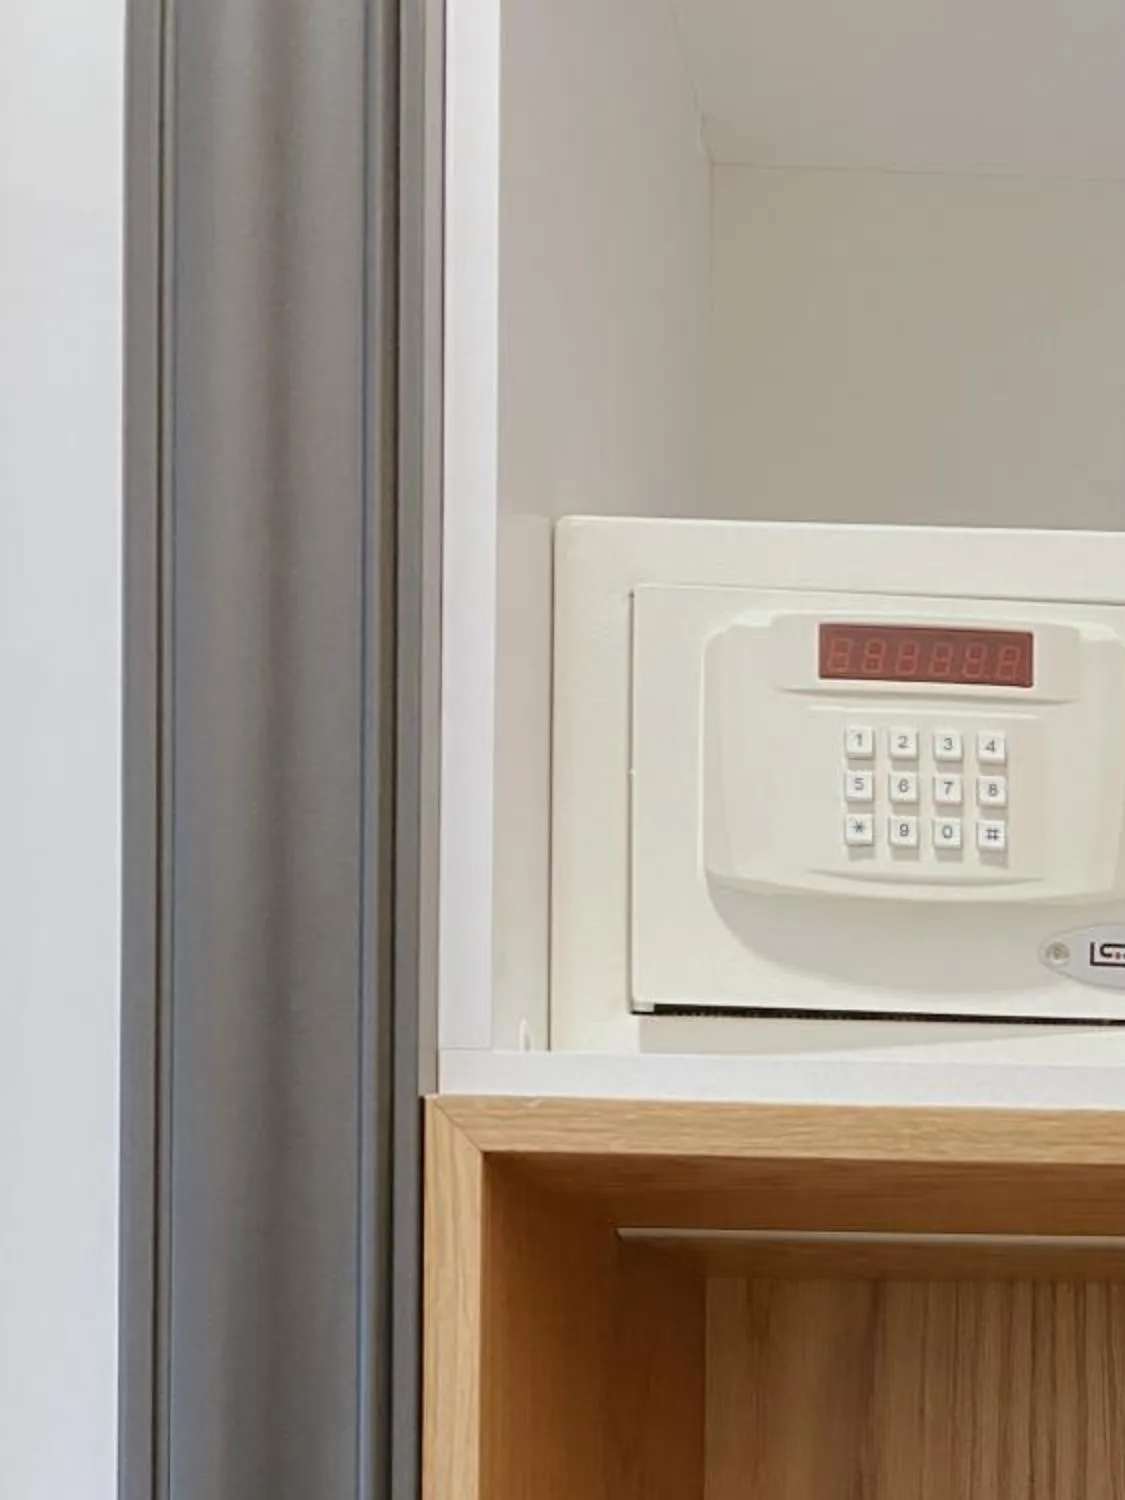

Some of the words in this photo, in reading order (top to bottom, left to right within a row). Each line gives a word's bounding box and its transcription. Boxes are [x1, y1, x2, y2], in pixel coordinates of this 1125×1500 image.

[897, 735, 909, 749] 2
[942, 737, 954, 751] 3
[984, 738, 997, 753] 4
[854, 777, 864, 791] 5
[898, 779, 909, 793] 6
[942, 782, 954, 796] 7
